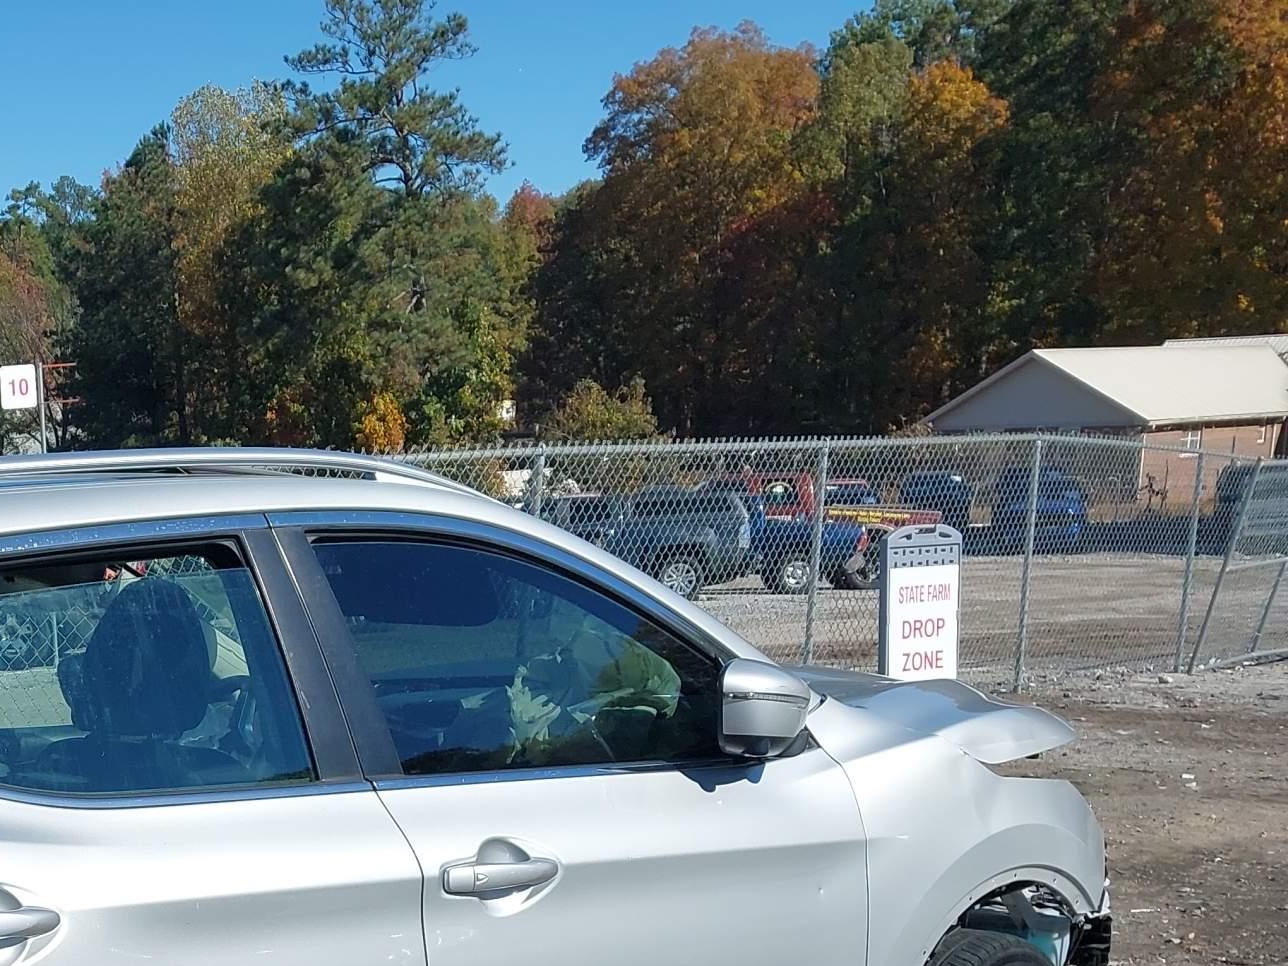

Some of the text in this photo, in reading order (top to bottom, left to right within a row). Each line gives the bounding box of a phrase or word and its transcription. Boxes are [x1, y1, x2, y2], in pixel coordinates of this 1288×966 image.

[8, 378, 29, 397] 10
[898, 583, 951, 604] STATE FARM
[902, 618, 945, 640] DROP
[902, 650, 944, 672] ZONE
